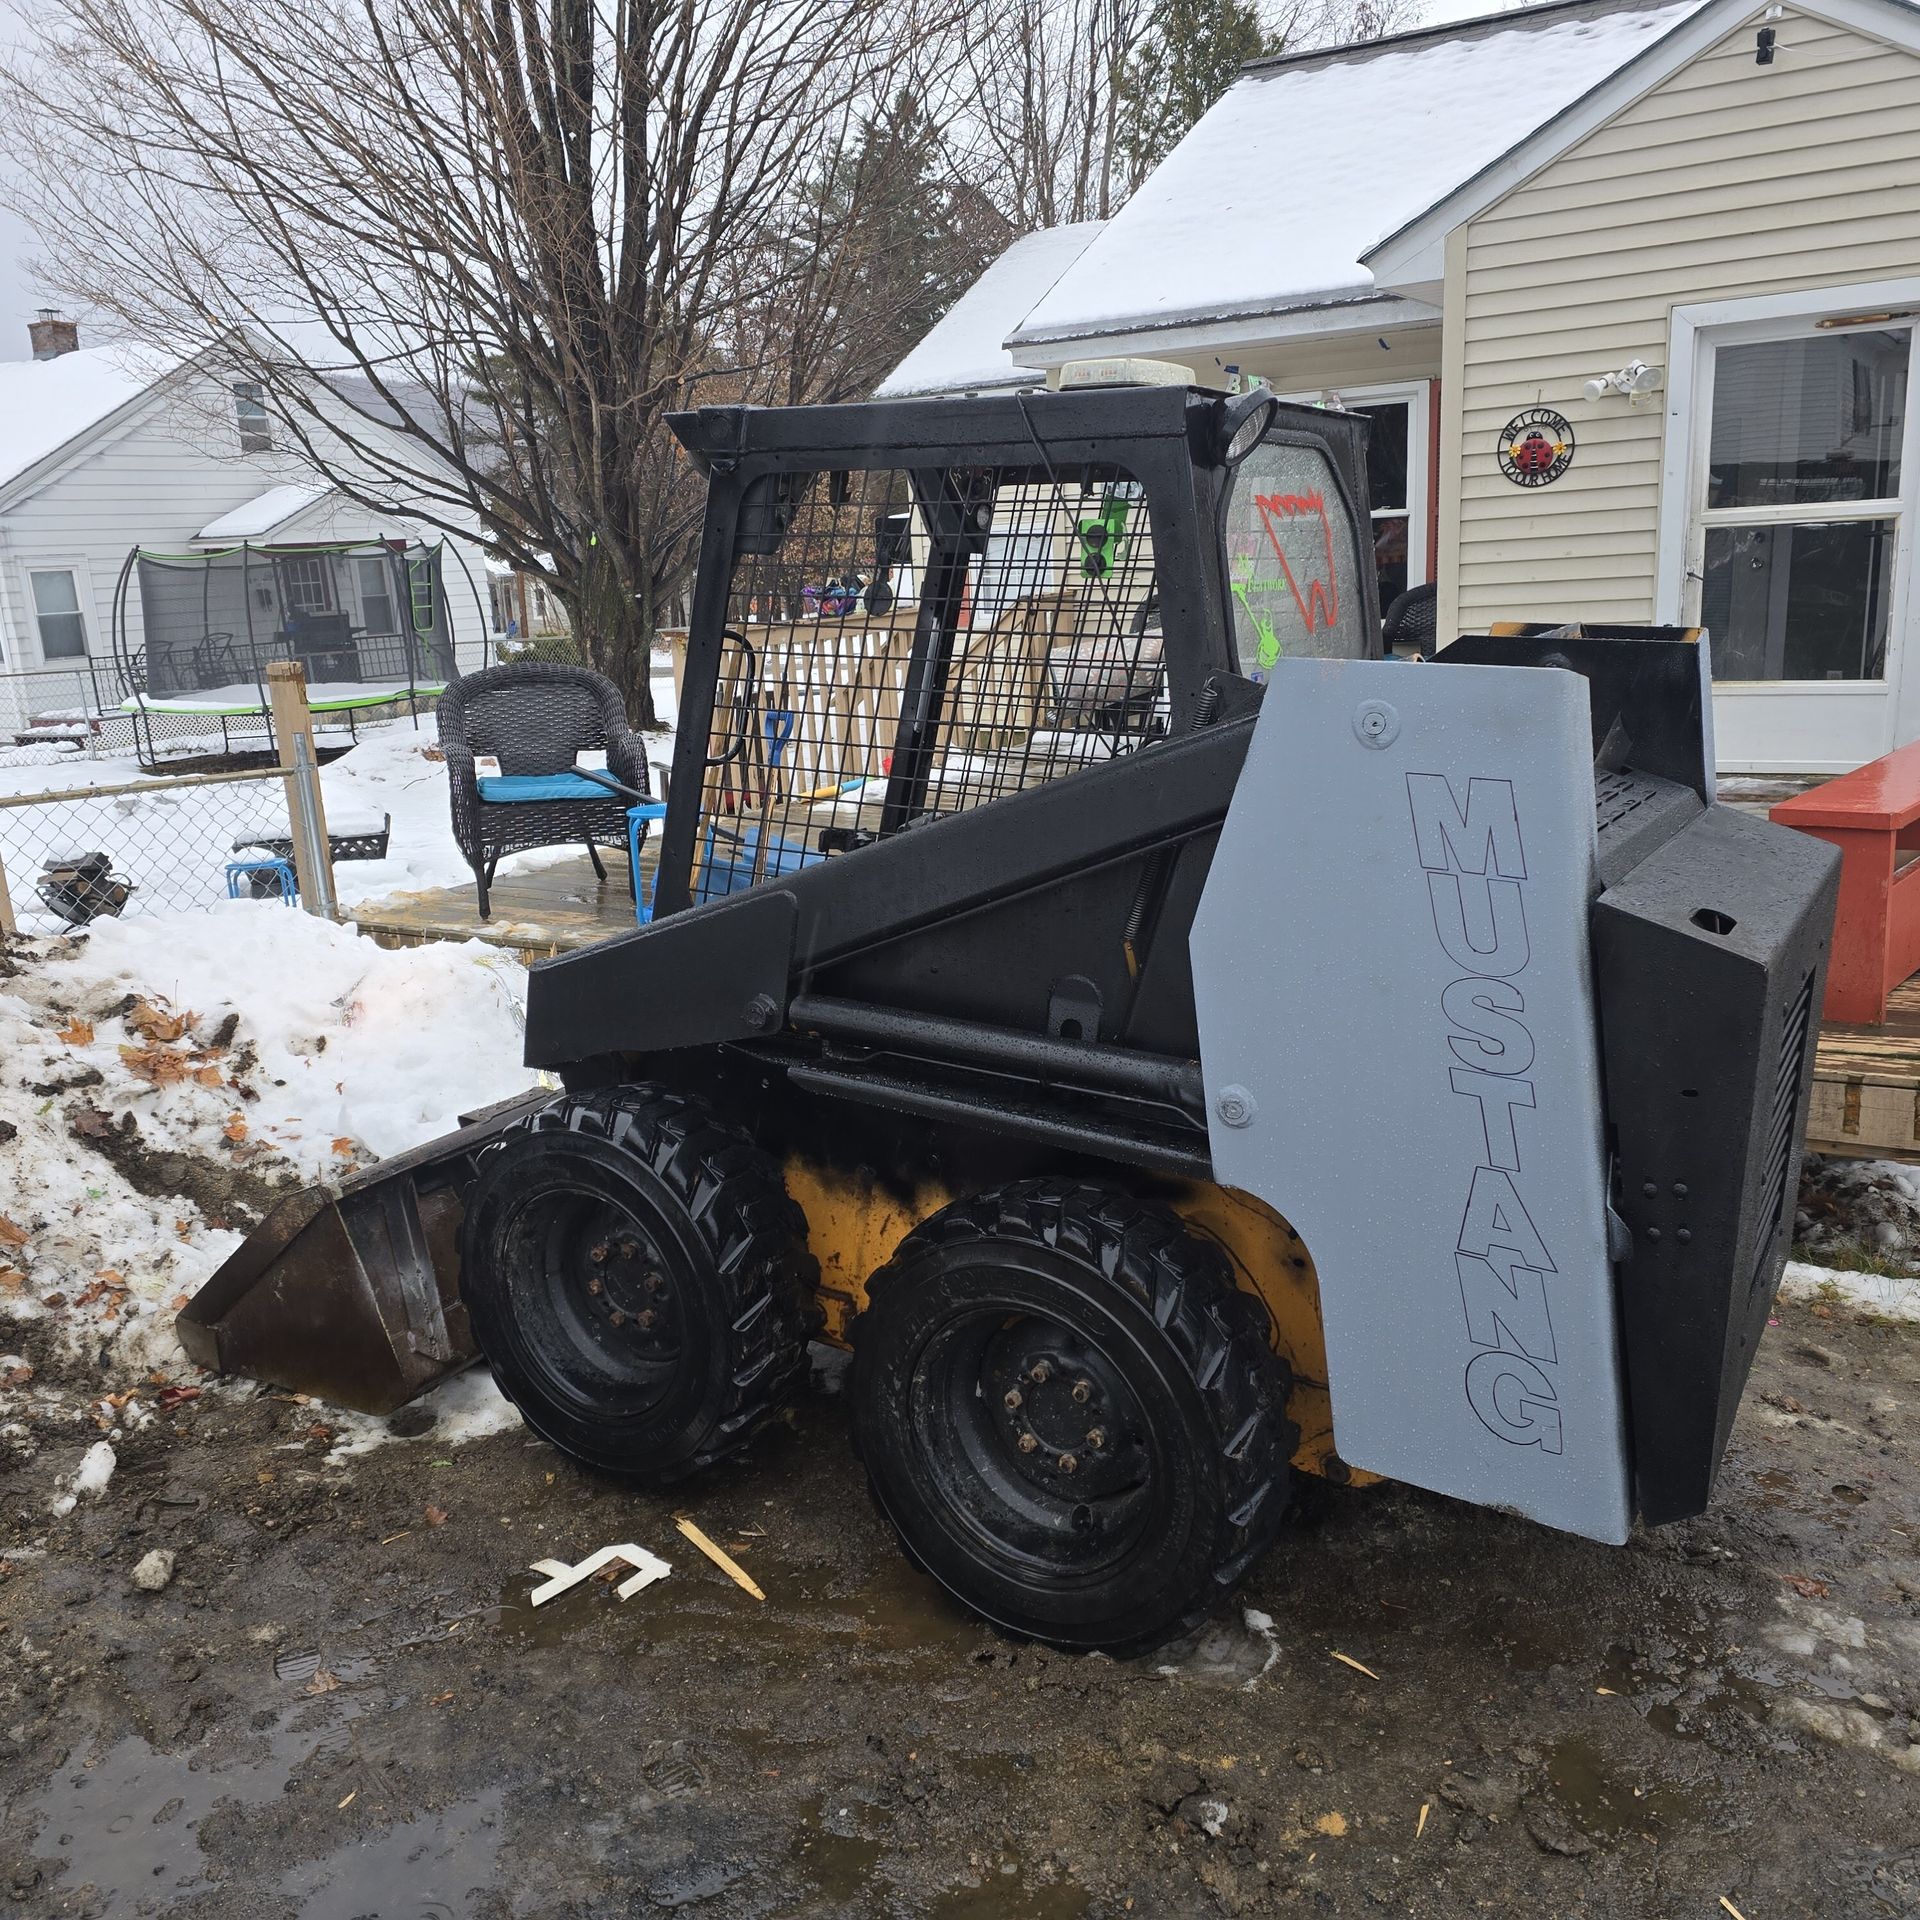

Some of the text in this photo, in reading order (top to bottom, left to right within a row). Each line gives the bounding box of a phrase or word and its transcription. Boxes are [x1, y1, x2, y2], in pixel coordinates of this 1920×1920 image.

[1502, 409, 1566, 441] WELCOME
[1515, 472, 1539, 486] OUR
[1541, 455, 1568, 484] HOME
[1405, 772, 1562, 1456] MUSTANG
